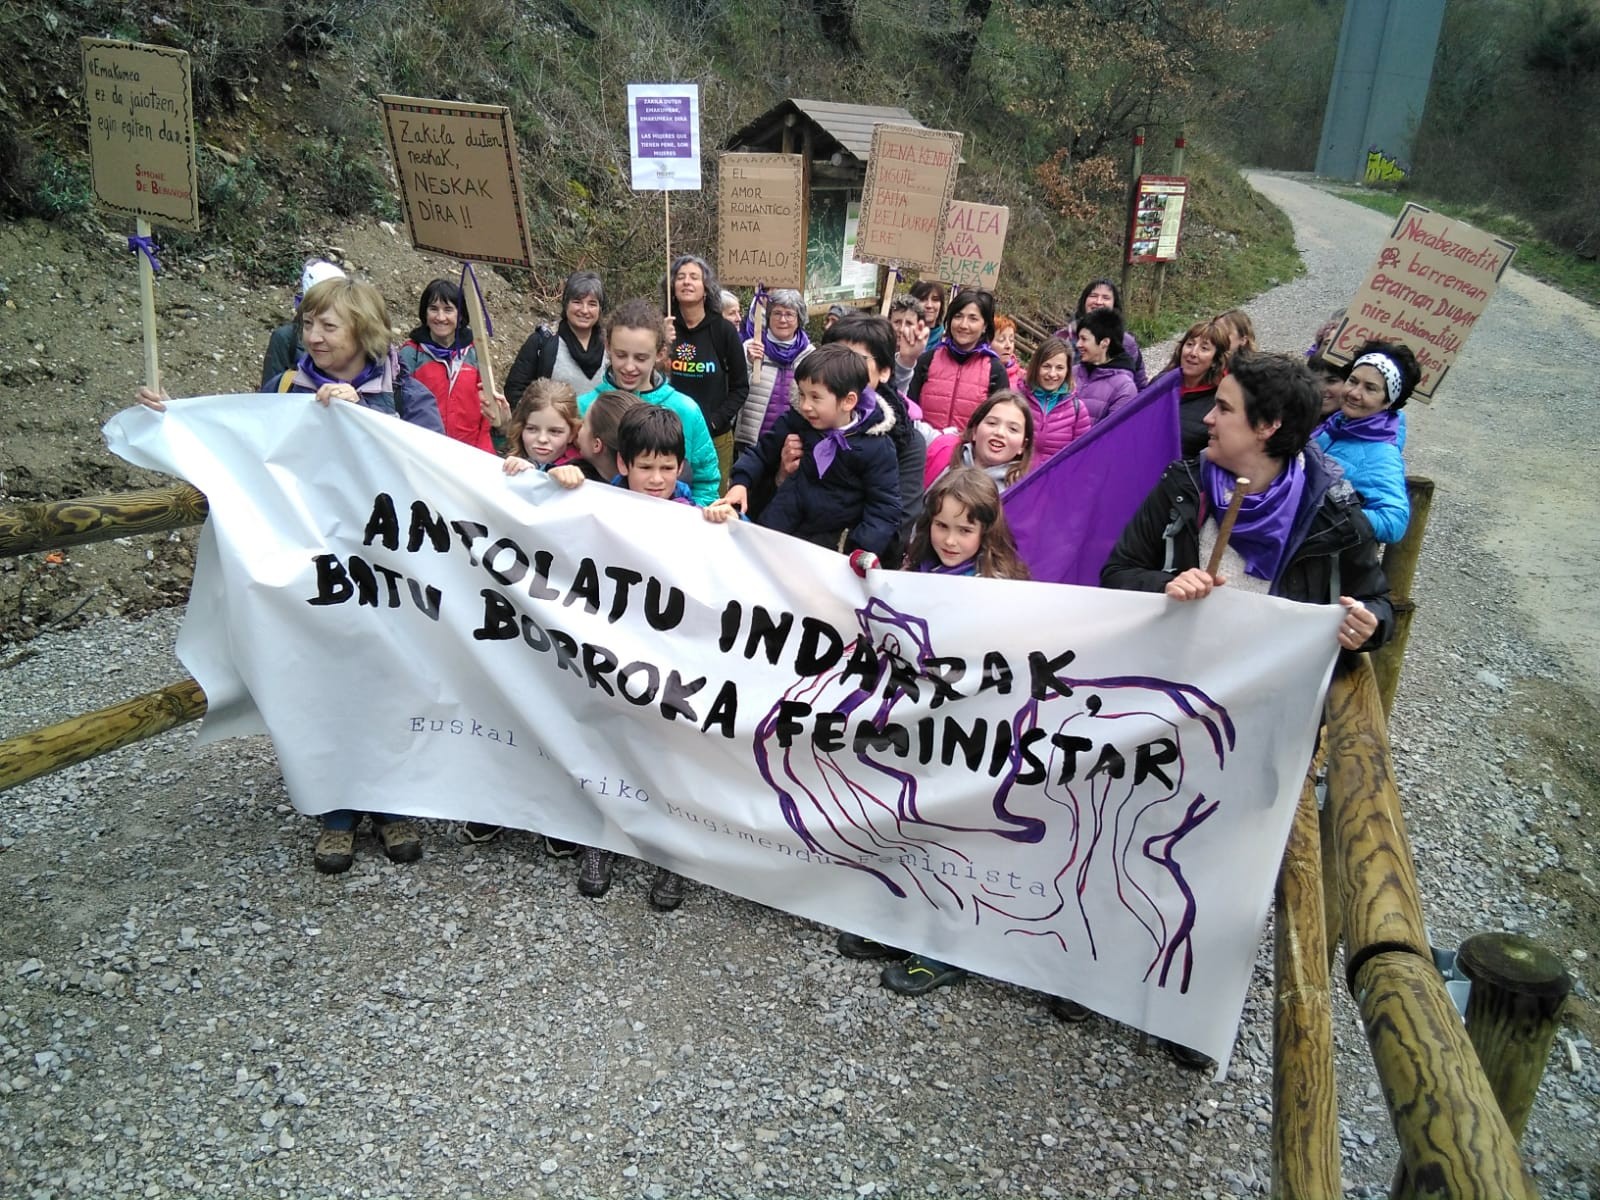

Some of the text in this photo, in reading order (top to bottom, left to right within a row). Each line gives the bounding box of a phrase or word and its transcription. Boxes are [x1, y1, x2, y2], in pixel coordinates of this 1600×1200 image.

[95, 88, 106, 102] ez
[112, 85, 124, 105] da
[98, 115, 117, 140] egin
[414, 172, 494, 199] NESKAK
[732, 168, 747, 179] EL
[731, 186, 762, 199] AMOR
[731, 221, 761, 233] MATA
[955, 231, 975, 244] ETA
[1408, 252, 1487, 302] barrenean
[1370, 273, 1434, 312] eraman
[1360, 300, 1391, 324] nire
[363, 492, 685, 632] ANTOLATU
[306, 553, 1181, 791] BATU BORROKA FEMINISTAR
[409, 716, 518, 747] Euskal
[664, 800, 833, 865] Mugimendu
[857, 853, 1047, 898] Feminista
